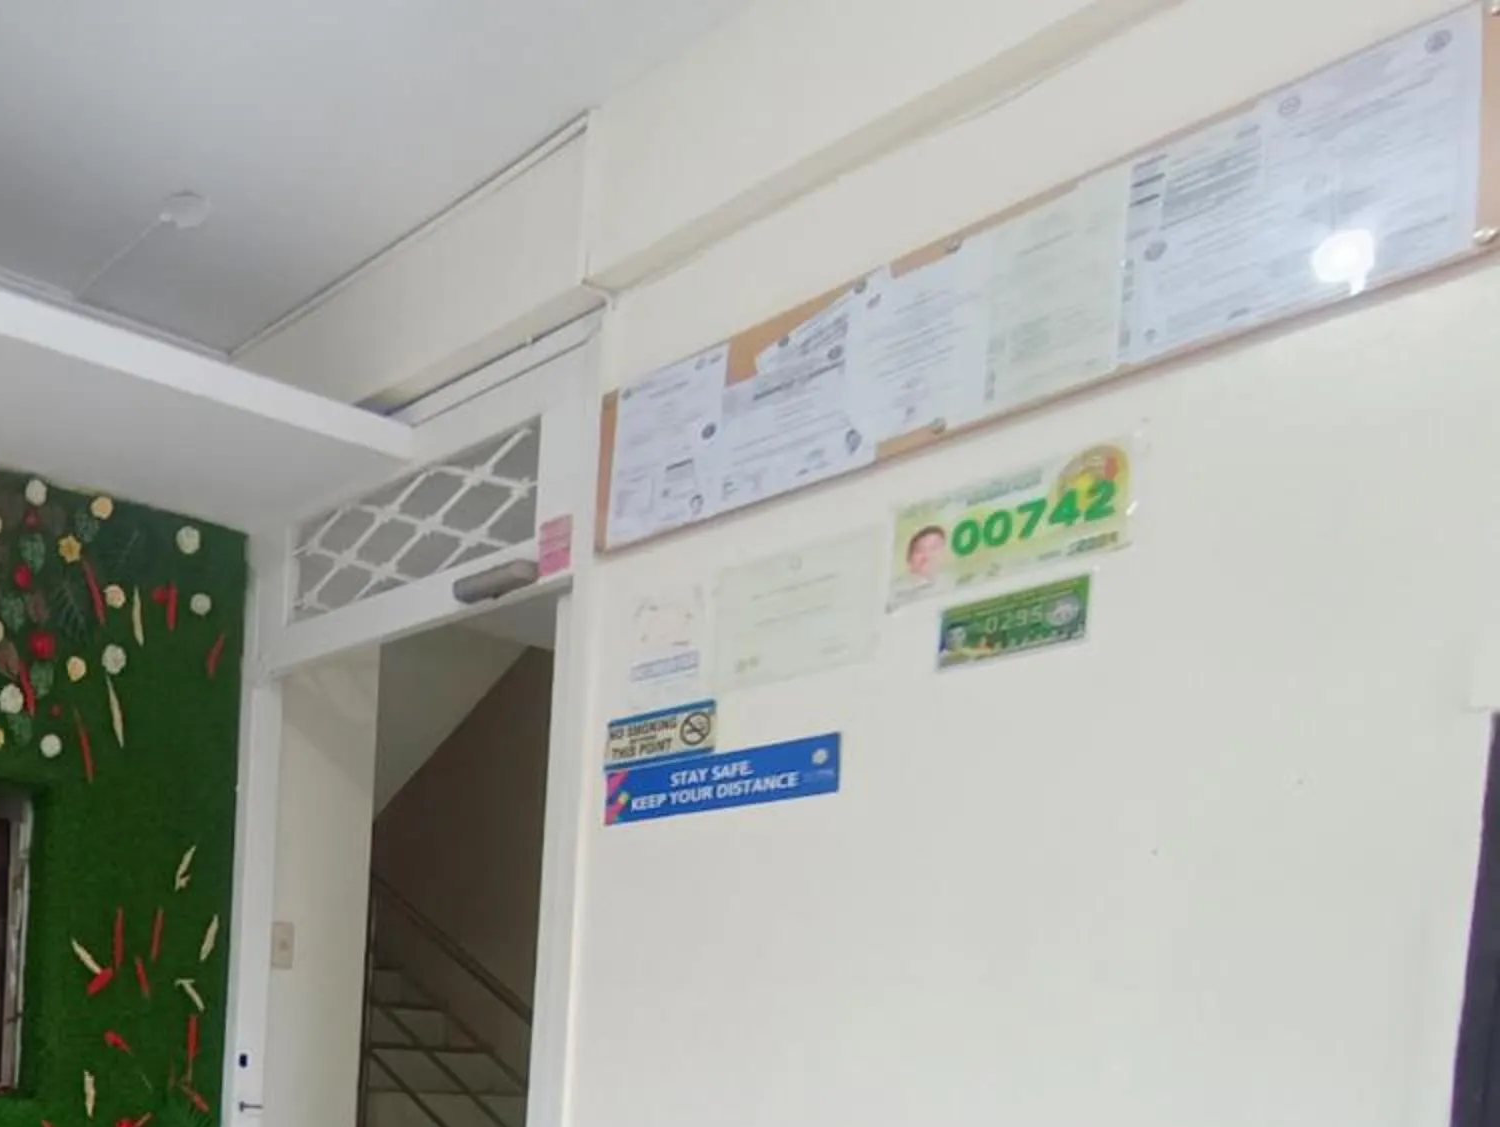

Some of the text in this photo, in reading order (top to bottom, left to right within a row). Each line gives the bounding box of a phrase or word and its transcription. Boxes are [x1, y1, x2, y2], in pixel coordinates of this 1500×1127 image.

[951, 478, 1117, 556] 00742
[627, 718, 677, 737] SMOKING
[638, 737, 673, 755] POINT
[670, 768, 708, 788] STAY
[631, 793, 666, 812] KEEP
[670, 784, 714, 805] YOUR
[716, 772, 799, 799] DISTANCE
